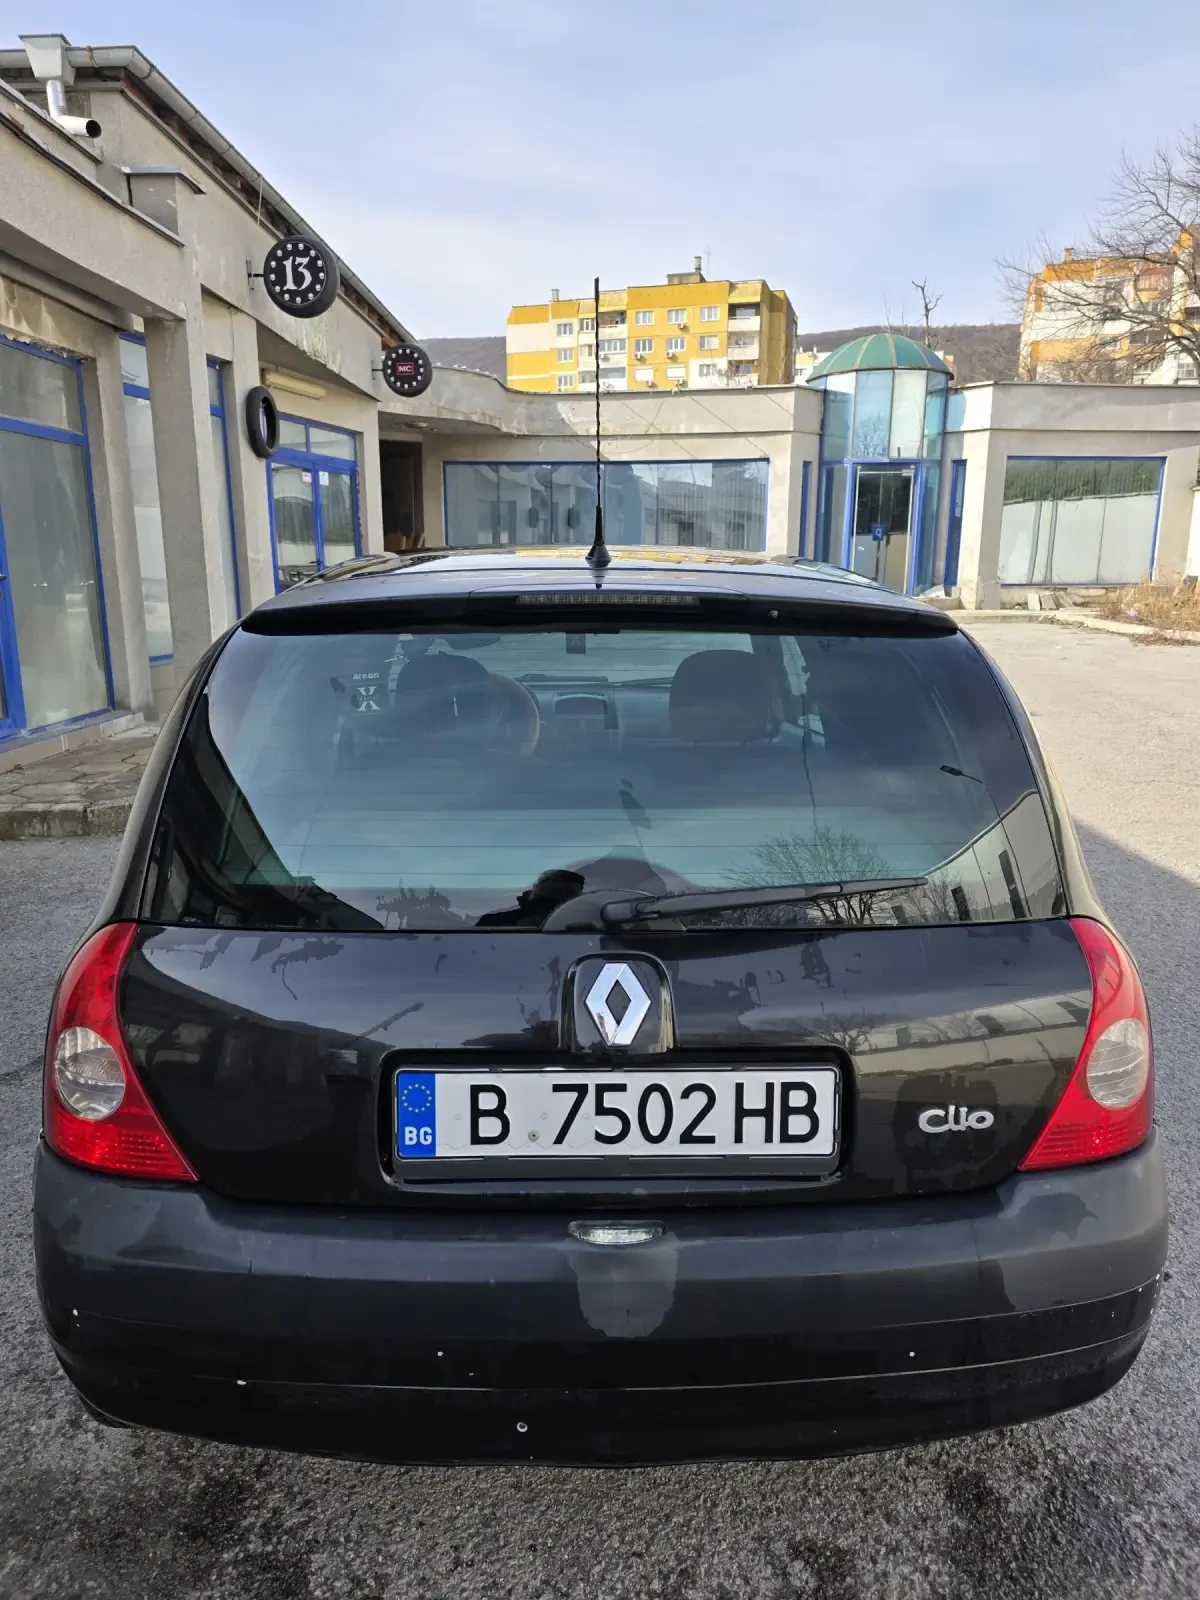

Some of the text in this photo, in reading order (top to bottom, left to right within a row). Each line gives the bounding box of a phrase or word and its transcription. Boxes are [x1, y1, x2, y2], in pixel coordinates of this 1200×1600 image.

[282, 255, 313, 291] 13
[398, 365, 412, 373] MC
[469, 1081, 820, 1146] B 7502 HB
[918, 1104, 995, 1134] Clio
[403, 1126, 433, 1146] BG
